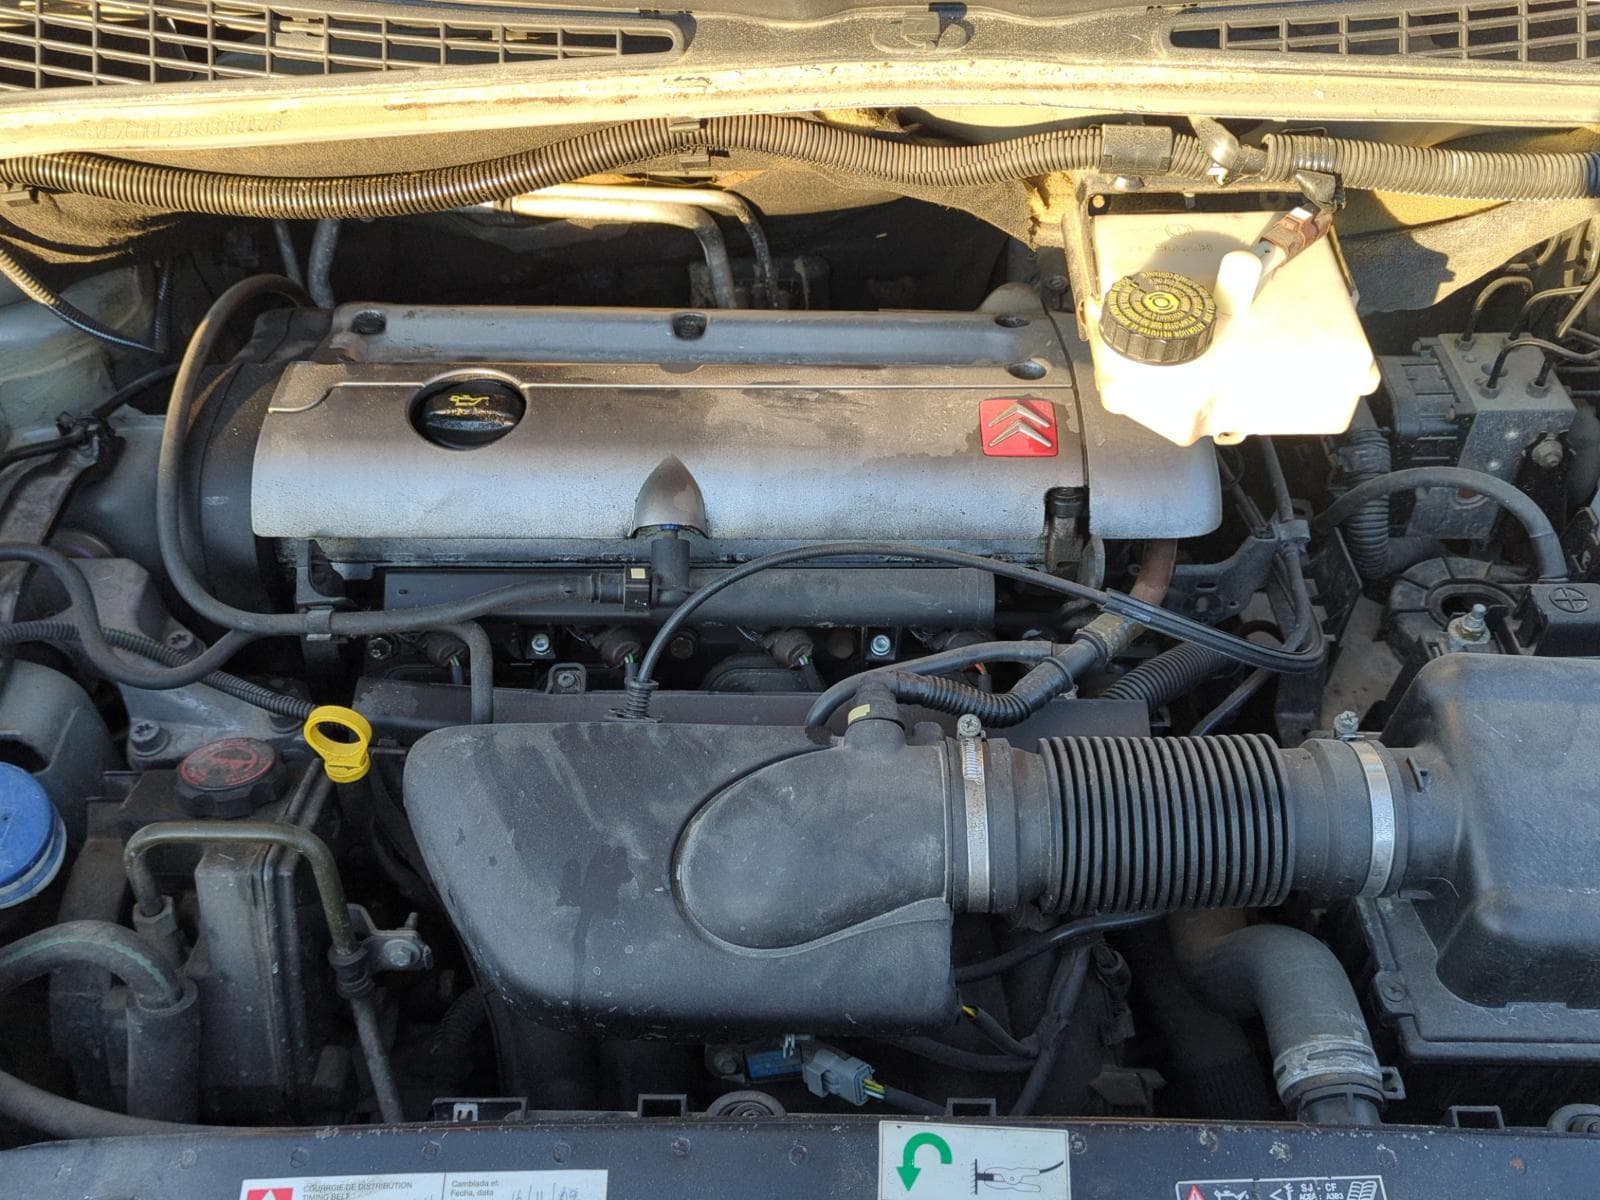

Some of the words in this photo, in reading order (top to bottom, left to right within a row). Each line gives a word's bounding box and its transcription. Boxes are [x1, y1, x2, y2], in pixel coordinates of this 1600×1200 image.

[345, 1183, 356, 1191] DE
[358, 1181, 413, 1190] DISTRIBUTION
[1300, 1183, 1314, 1192] SJ
[1324, 1182, 1337, 1192] CF
